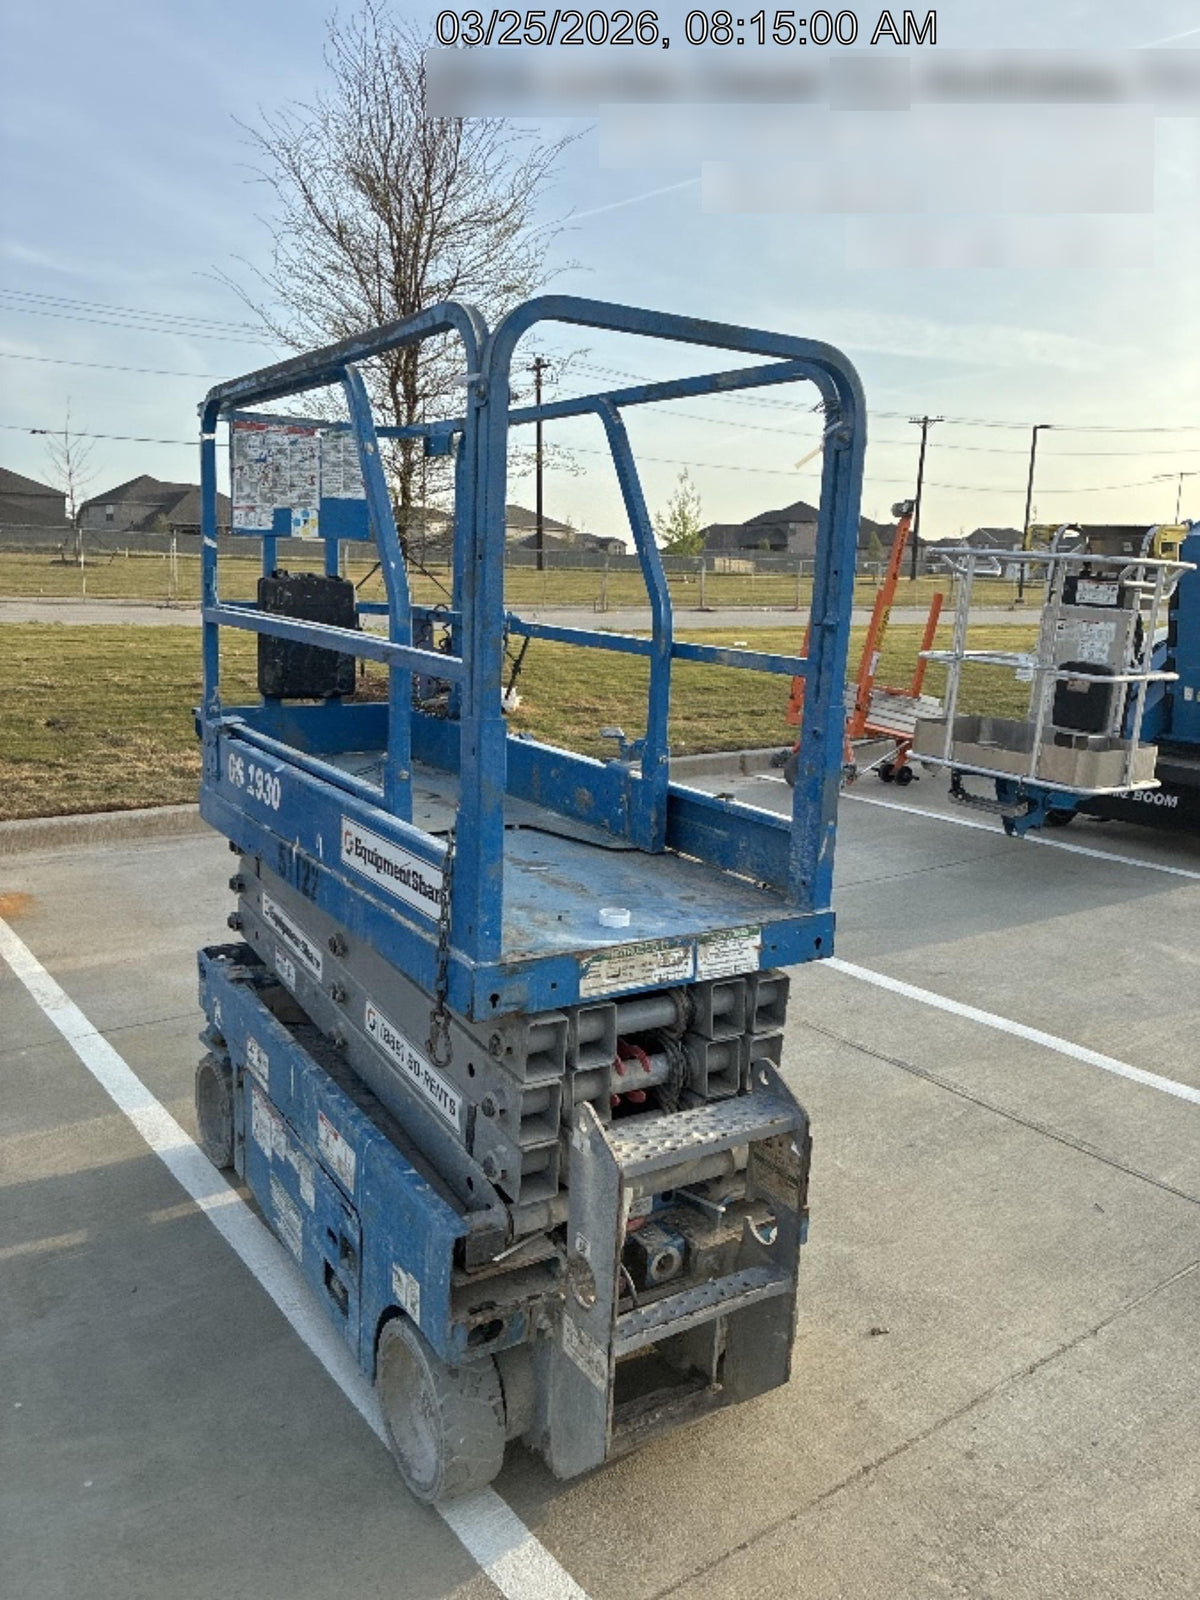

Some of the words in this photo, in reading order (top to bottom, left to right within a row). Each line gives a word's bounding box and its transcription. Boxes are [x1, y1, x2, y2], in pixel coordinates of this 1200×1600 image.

[229, 753, 244, 788] GS
[247, 764, 281, 811] 1930
[1132, 790, 1179, 808] BOOM
